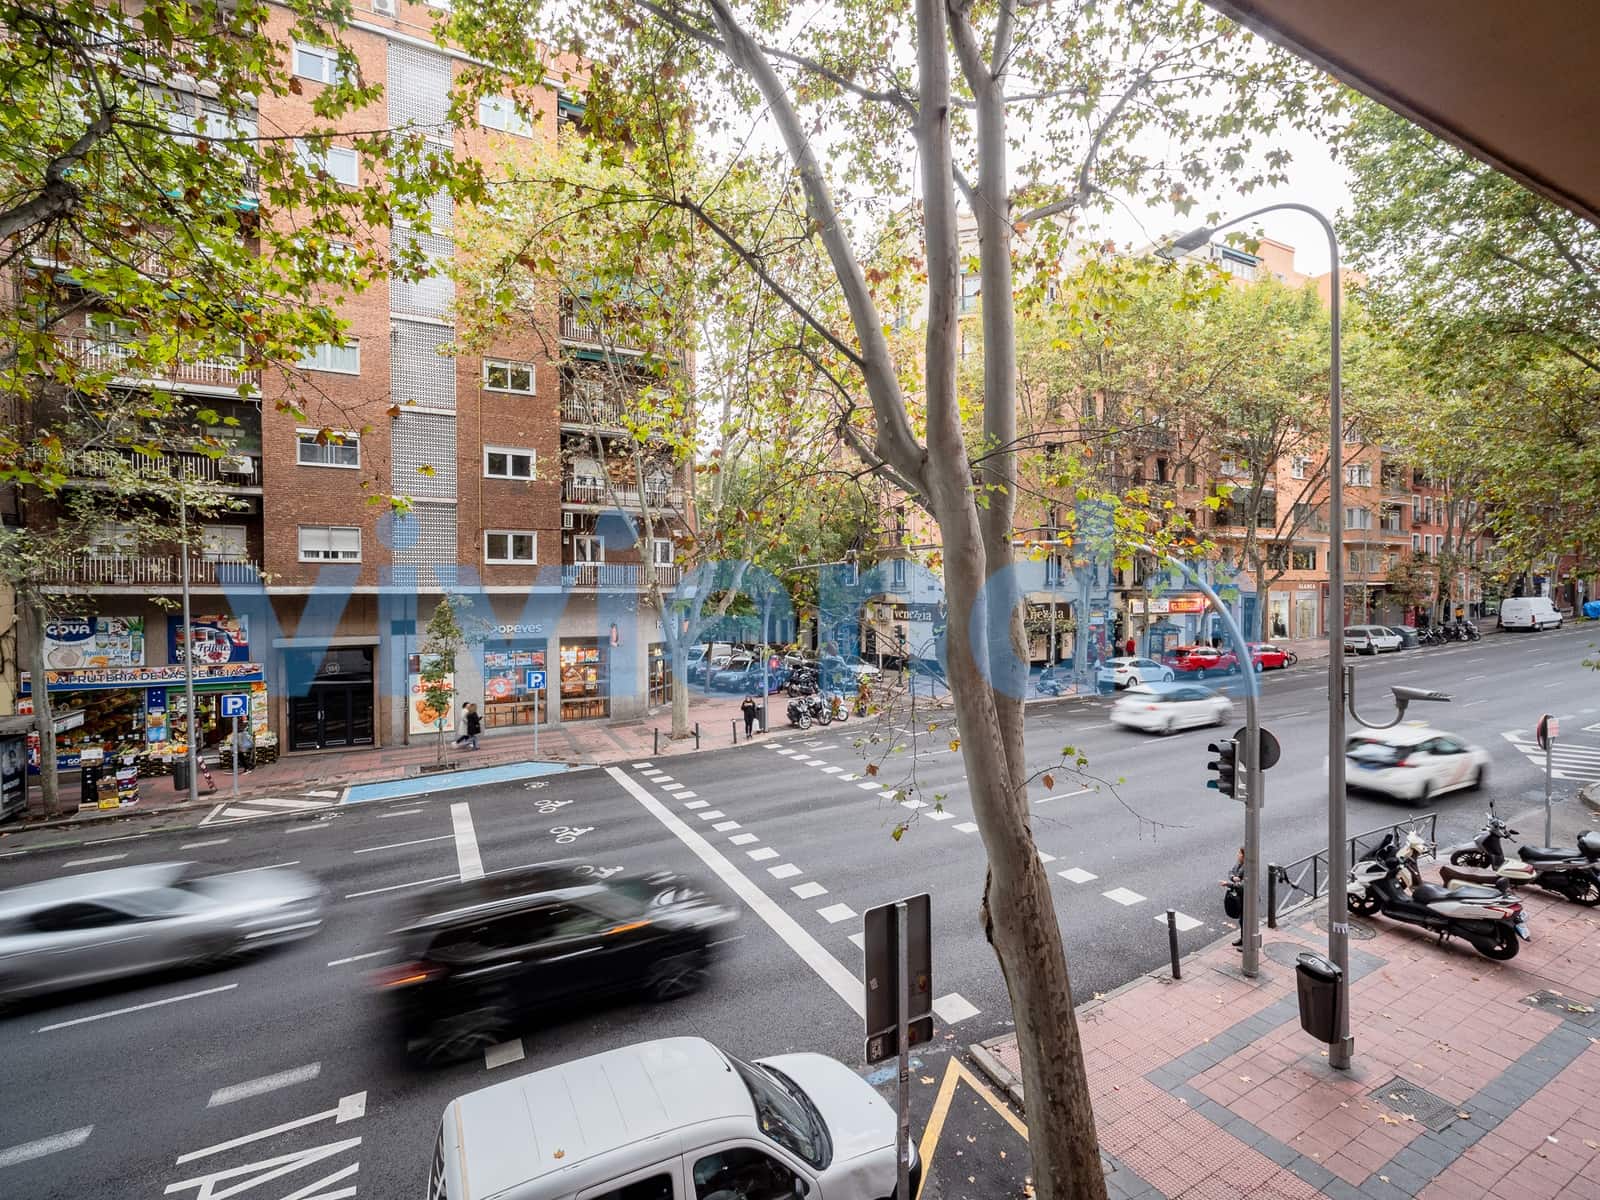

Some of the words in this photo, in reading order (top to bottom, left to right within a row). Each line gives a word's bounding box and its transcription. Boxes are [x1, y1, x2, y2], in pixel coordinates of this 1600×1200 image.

[47, 625, 90, 636] GOYA
[141, 672, 157, 681] DE
[531, 673, 543, 688] P
[227, 697, 244, 714] P
